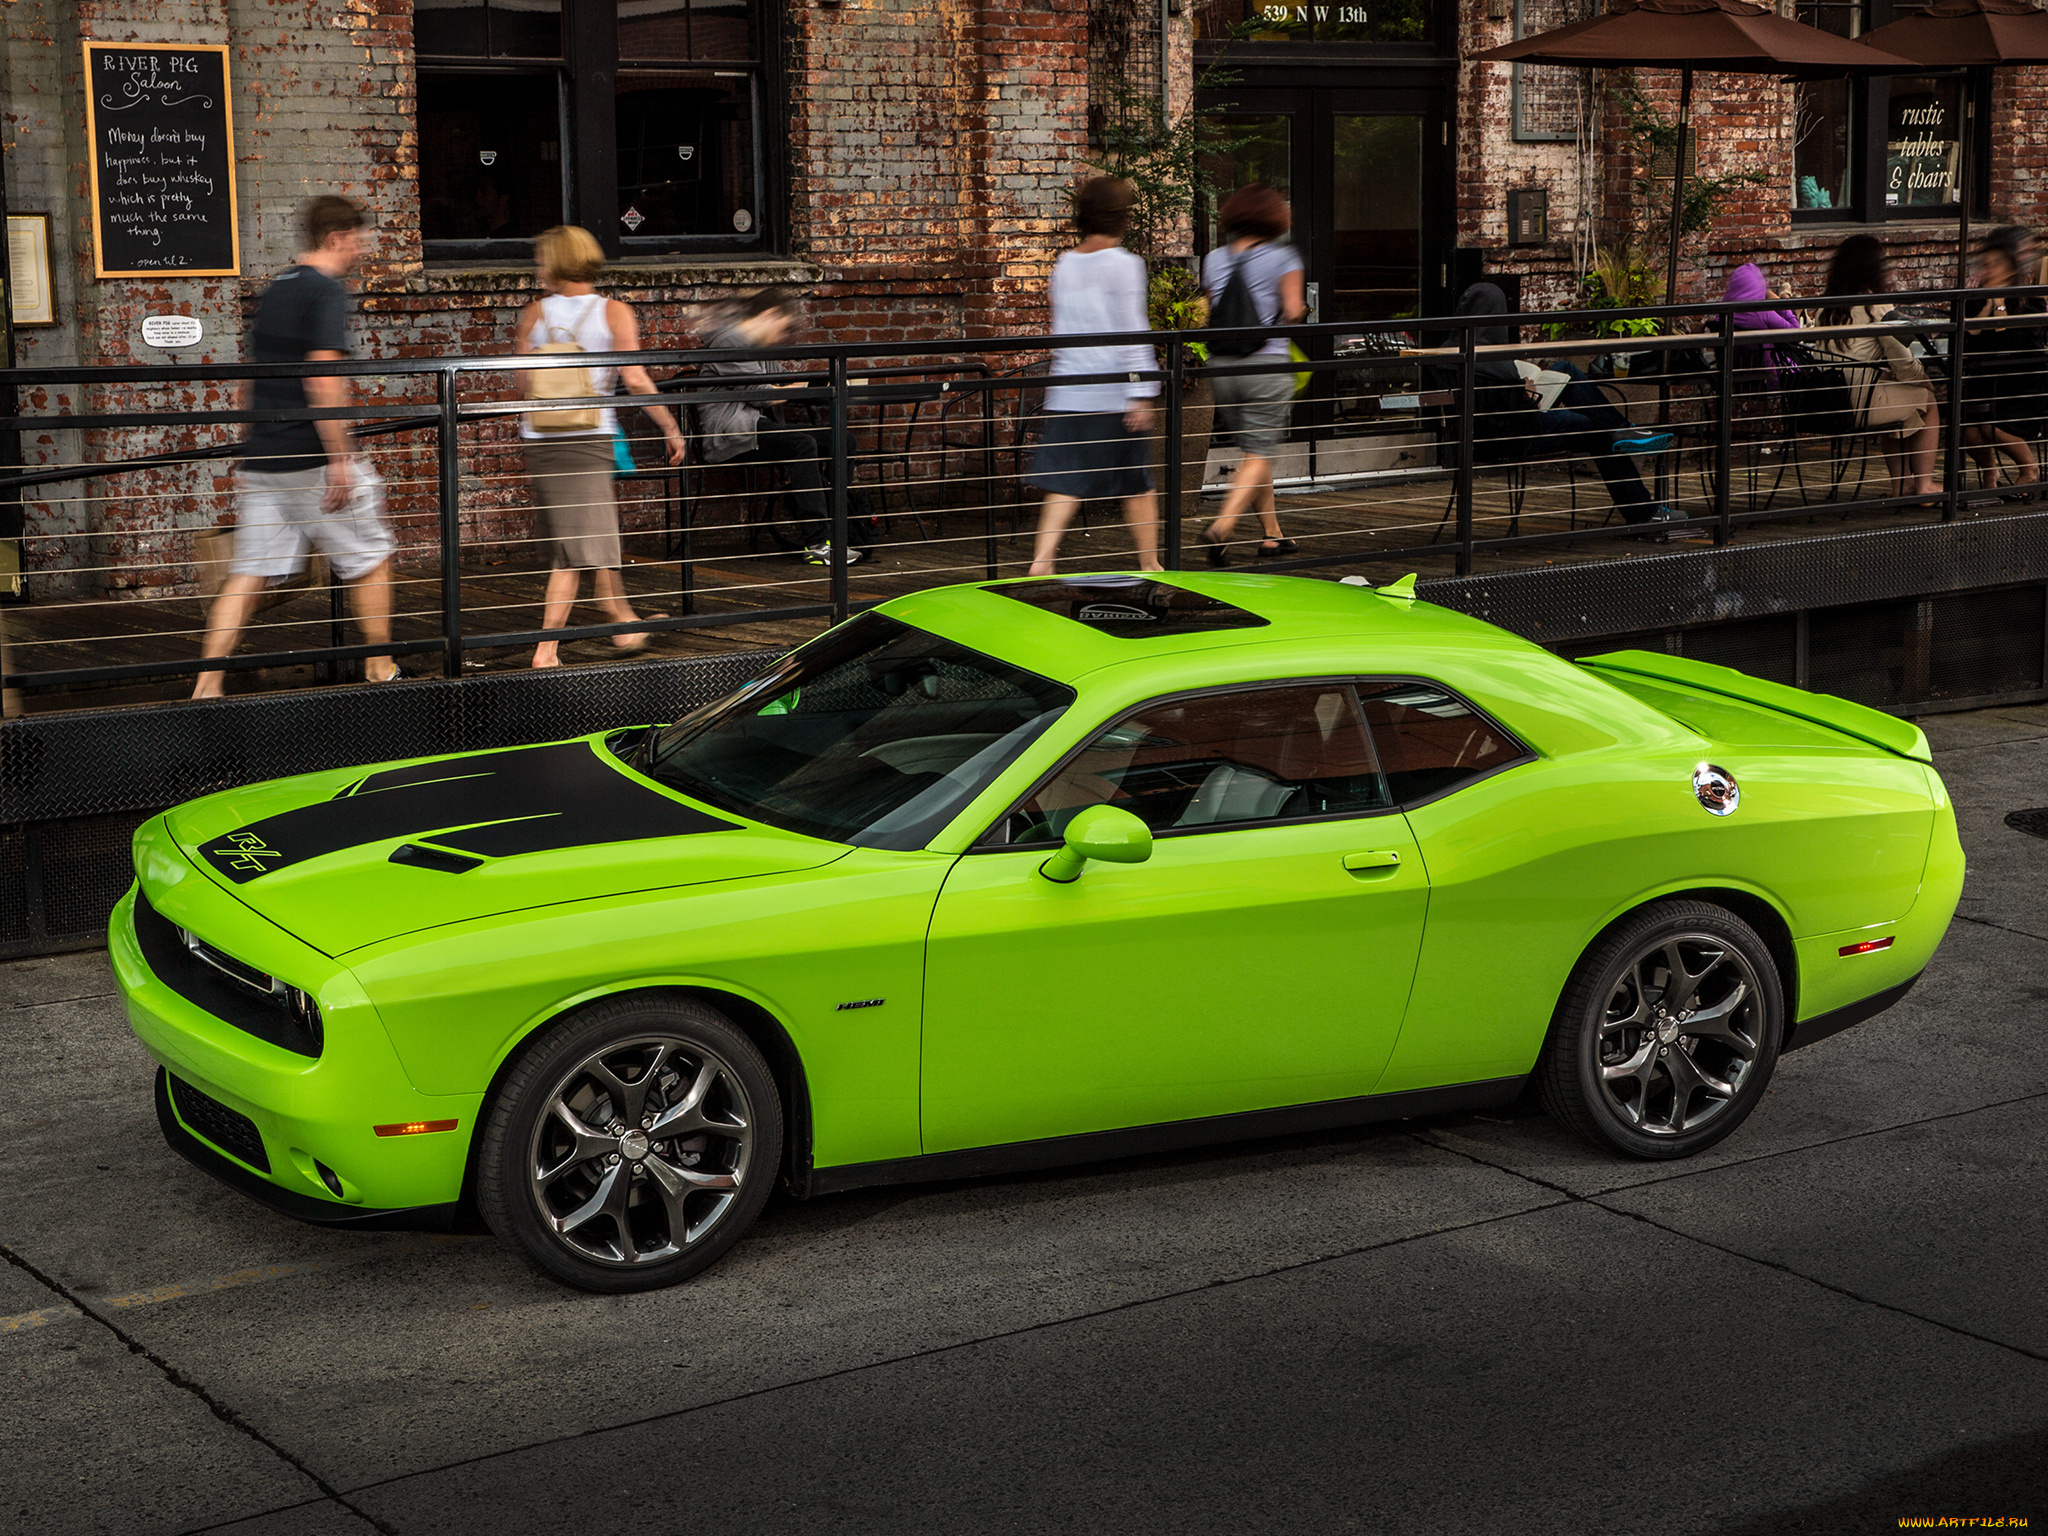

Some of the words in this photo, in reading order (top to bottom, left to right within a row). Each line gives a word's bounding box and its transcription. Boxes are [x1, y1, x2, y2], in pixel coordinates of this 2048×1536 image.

[1263, 5, 1288, 22] 539
[1339, 6, 1368, 23] 13th
[103, 55, 161, 72] RIVER
[169, 56, 199, 73] PIG
[122, 71, 182, 98] Saloon
[1901, 100, 1945, 125] rustic
[108, 127, 145, 155] Money
[185, 129, 206, 151] buy
[1900, 131, 1945, 157] tables
[161, 152, 183, 165] but
[186, 154, 198, 166] it
[116, 174, 138, 186] does
[142, 173, 167, 193] buy
[170, 170, 214, 195] whiskey
[1889, 165, 1903, 189] &
[1907, 162, 1953, 189] chairs
[108, 191, 144, 205] which
[147, 193, 156, 204] is
[160, 191, 193, 211] pretty
[110, 212, 144, 223] much
[148, 211, 168, 223] the
[172, 213, 209, 223] same
[213, 832, 282, 872] R/T
